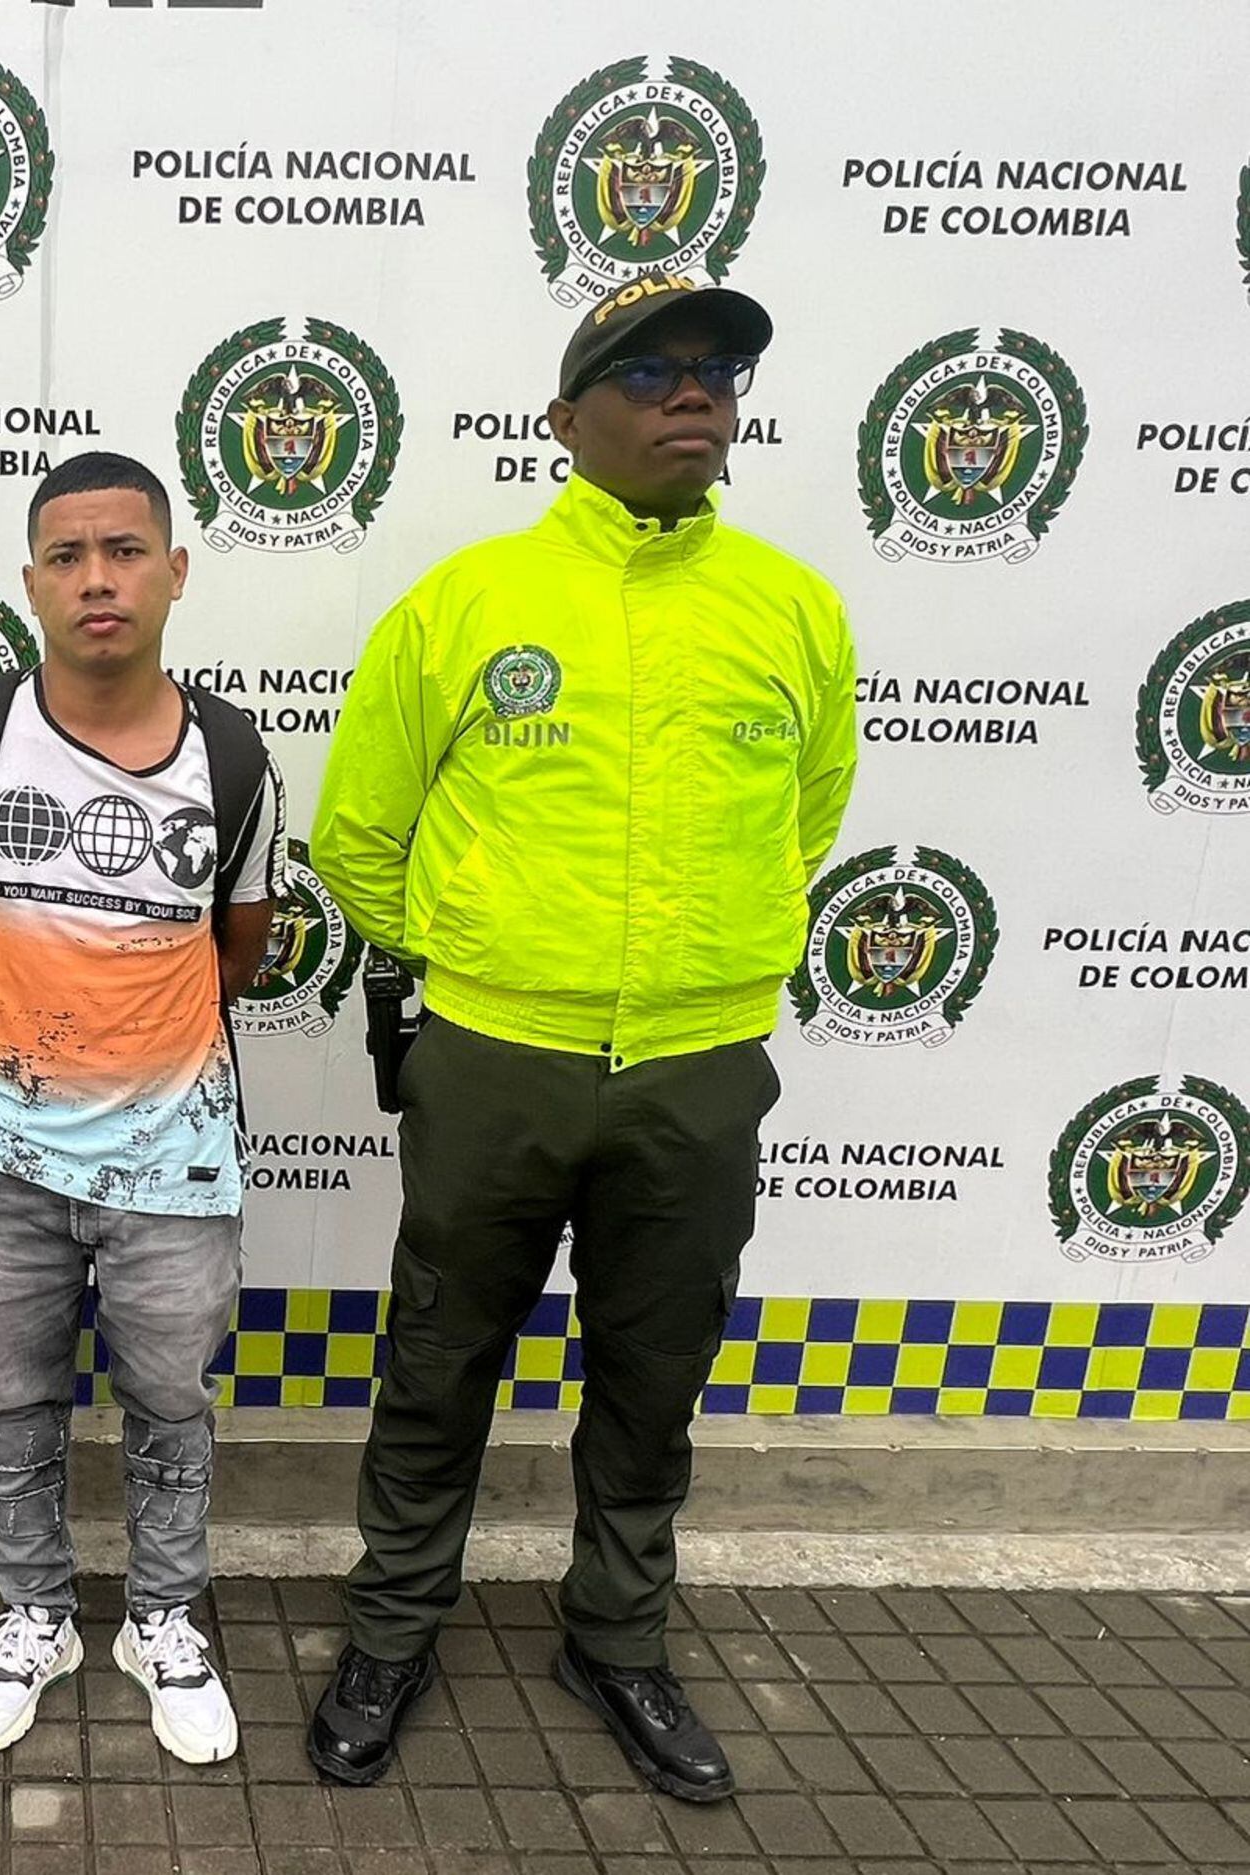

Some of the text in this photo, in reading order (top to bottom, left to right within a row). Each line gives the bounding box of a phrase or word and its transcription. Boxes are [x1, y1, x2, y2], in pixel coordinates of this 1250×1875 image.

[646, 85, 671, 100] DE
[689, 98, 735, 199] COLOMBIA
[133, 141, 476, 182] POLICÍA NACIONAL
[842, 151, 1187, 192] POLICÍA NACIONAL
[179, 196, 425, 226] DE COLOMBIA
[883, 205, 1130, 237] DE COLOMBIA
[285, 345, 309, 359] DE
[327, 357, 375, 451] COLOMBIA
[975, 356, 1000, 369] DE
[1016, 367, 1059, 461] COLOMBIA
[452, 413, 550, 441] POLIC
[1136, 416, 1250, 452] POLICÍ
[495, 456, 538, 483] DE
[1174, 466, 1220, 494] DE
[286, 471, 365, 525] NACIONAL
[959, 482, 1044, 535] NACIONAL
[284, 522, 342, 547] PATRIA
[955, 532, 1015, 557] PATRIA
[913, 678, 1090, 706] NACIONAL
[483, 721, 570, 747] DIJIN
[863, 717, 1039, 745] COLOMBIA
[3, 885, 28, 898] YOU
[31, 888, 63, 901] WANT
[66, 891, 122, 910] SUCCESS
[124, 901, 141, 912] BY
[297, 869, 341, 950] COLOMBIA
[894, 869, 917, 881] DE
[932, 879, 972, 960] COLOMBIA
[1043, 921, 1168, 953] POLICÍA
[260, 967, 332, 1013] NACIONAL
[1078, 965, 1248, 989] DE COLOM
[880, 978, 958, 1023] NACIONAL
[258, 1010, 312, 1032] PATRIA
[876, 1020, 932, 1042] PATRIA
[1160, 1096, 1182, 1108] DE
[1197, 1106, 1236, 1182] COLOMBIA
[841, 1142, 1005, 1168] NACIONAL
[794, 1177, 958, 1201] COLOMBIA
[1142, 1198, 1221, 1240] NACIONAL
[1137, 1238, 1193, 1258] PATRIA
